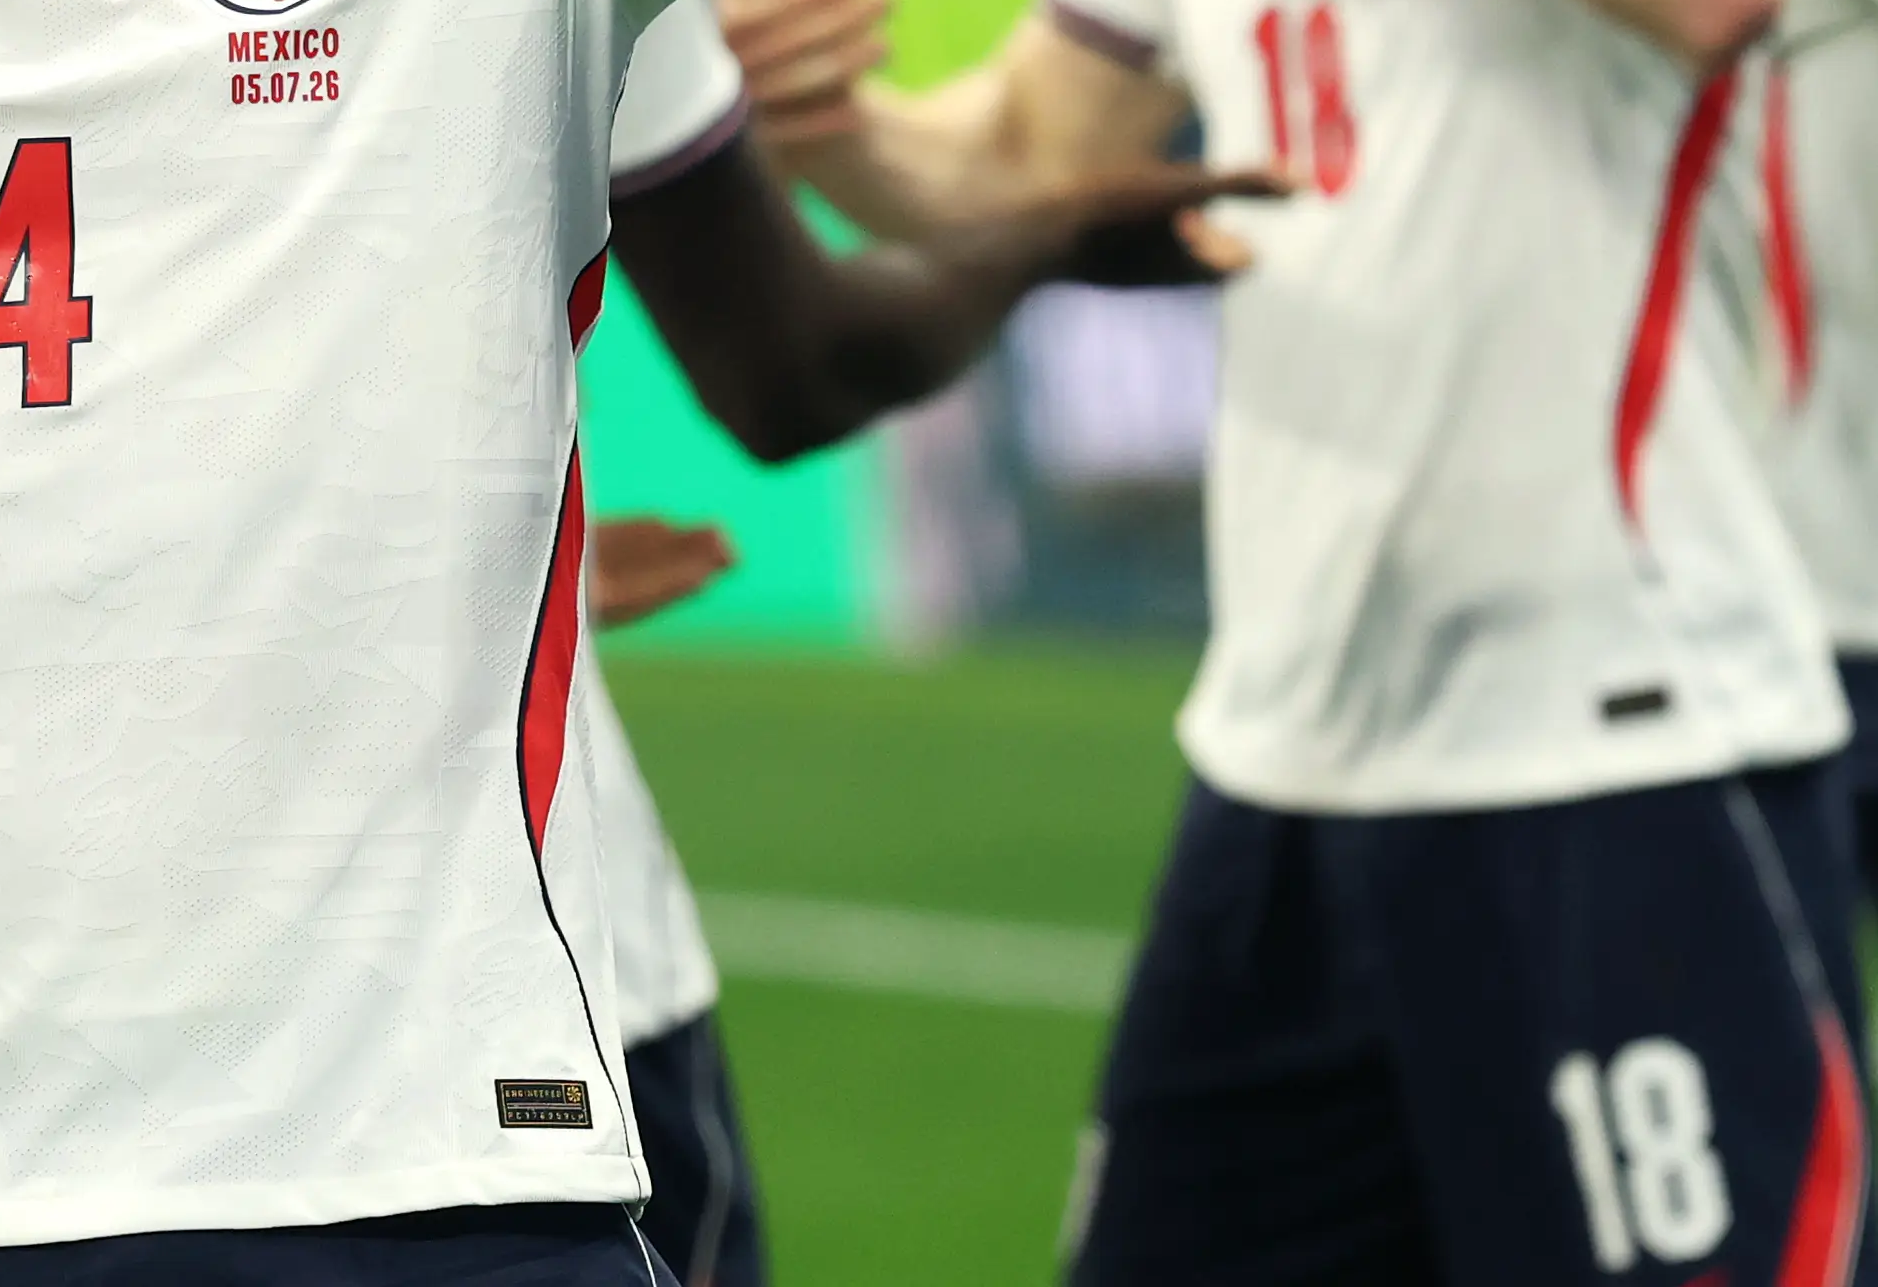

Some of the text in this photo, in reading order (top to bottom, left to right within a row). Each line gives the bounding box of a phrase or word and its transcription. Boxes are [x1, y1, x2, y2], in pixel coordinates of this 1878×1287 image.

[228, 27, 339, 62] MEXICO
[231, 70, 339, 104] 05.07.26
[1253, 3, 1356, 199] 18
[1550, 1036, 1733, 1272] 18
